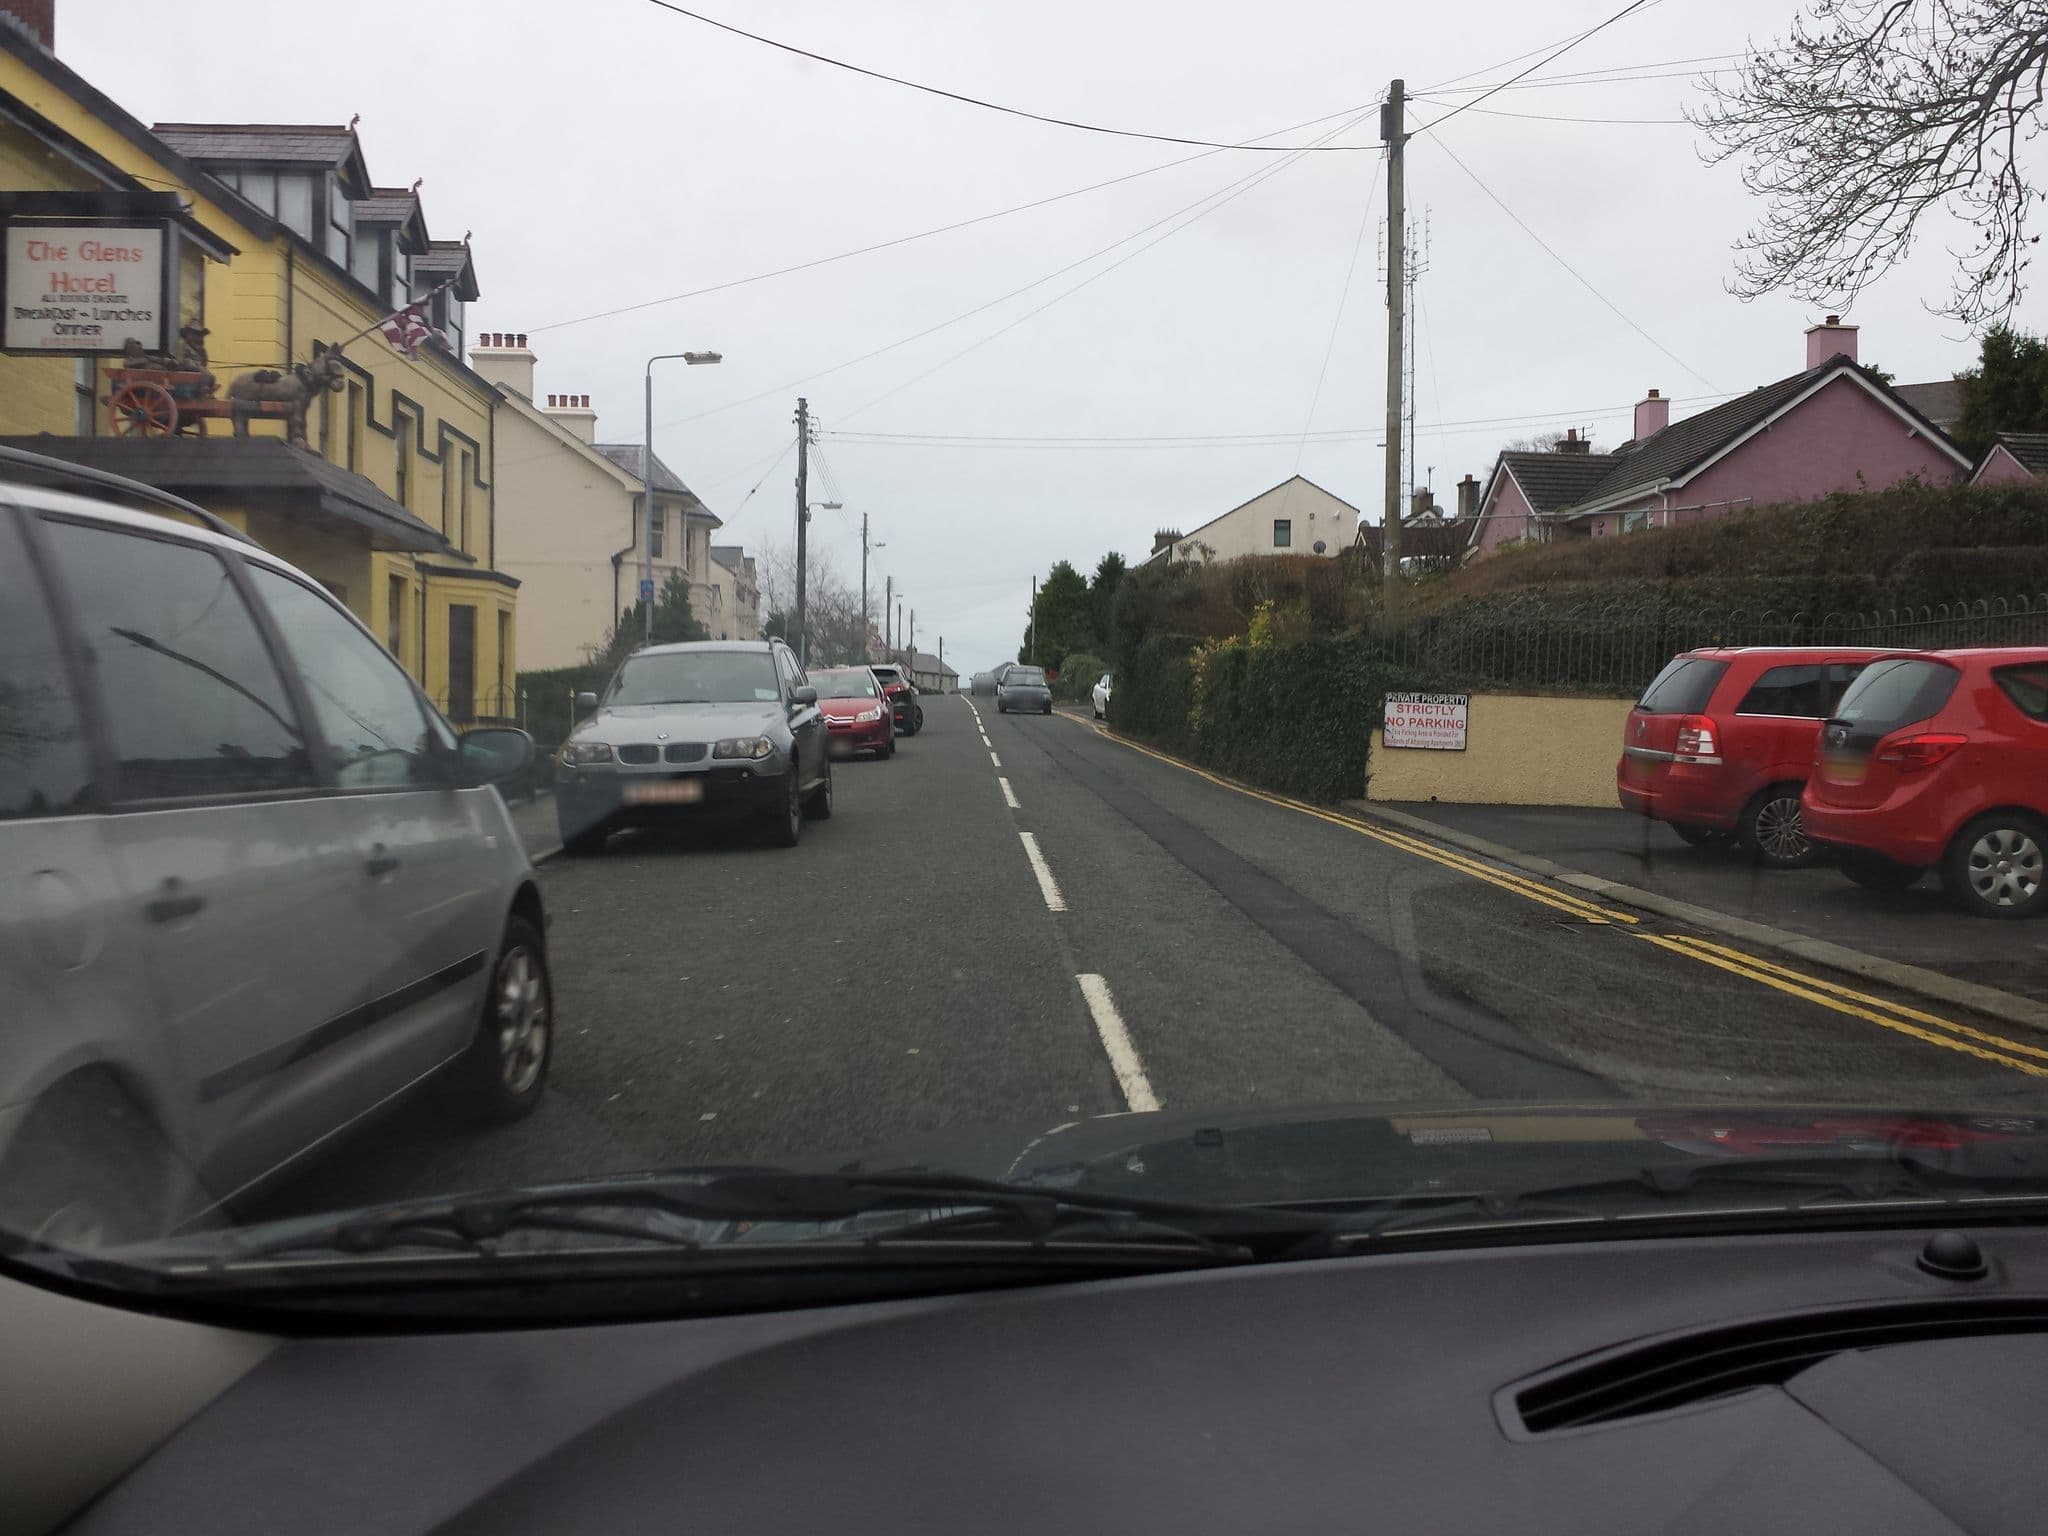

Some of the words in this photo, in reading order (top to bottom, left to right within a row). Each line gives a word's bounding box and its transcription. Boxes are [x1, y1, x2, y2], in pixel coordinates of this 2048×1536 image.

[27, 240, 67, 261] The
[79, 240, 144, 262] Glens
[48, 272, 117, 293] Hotel
[93, 308, 152, 321] Lunches
[1387, 692, 1420, 704] PRIVATE
[1422, 694, 1465, 706] PROPERTY
[1396, 703, 1456, 716] STRICTLY
[1386, 716, 1405, 727] NO
[1409, 717, 1464, 729] PARKING
